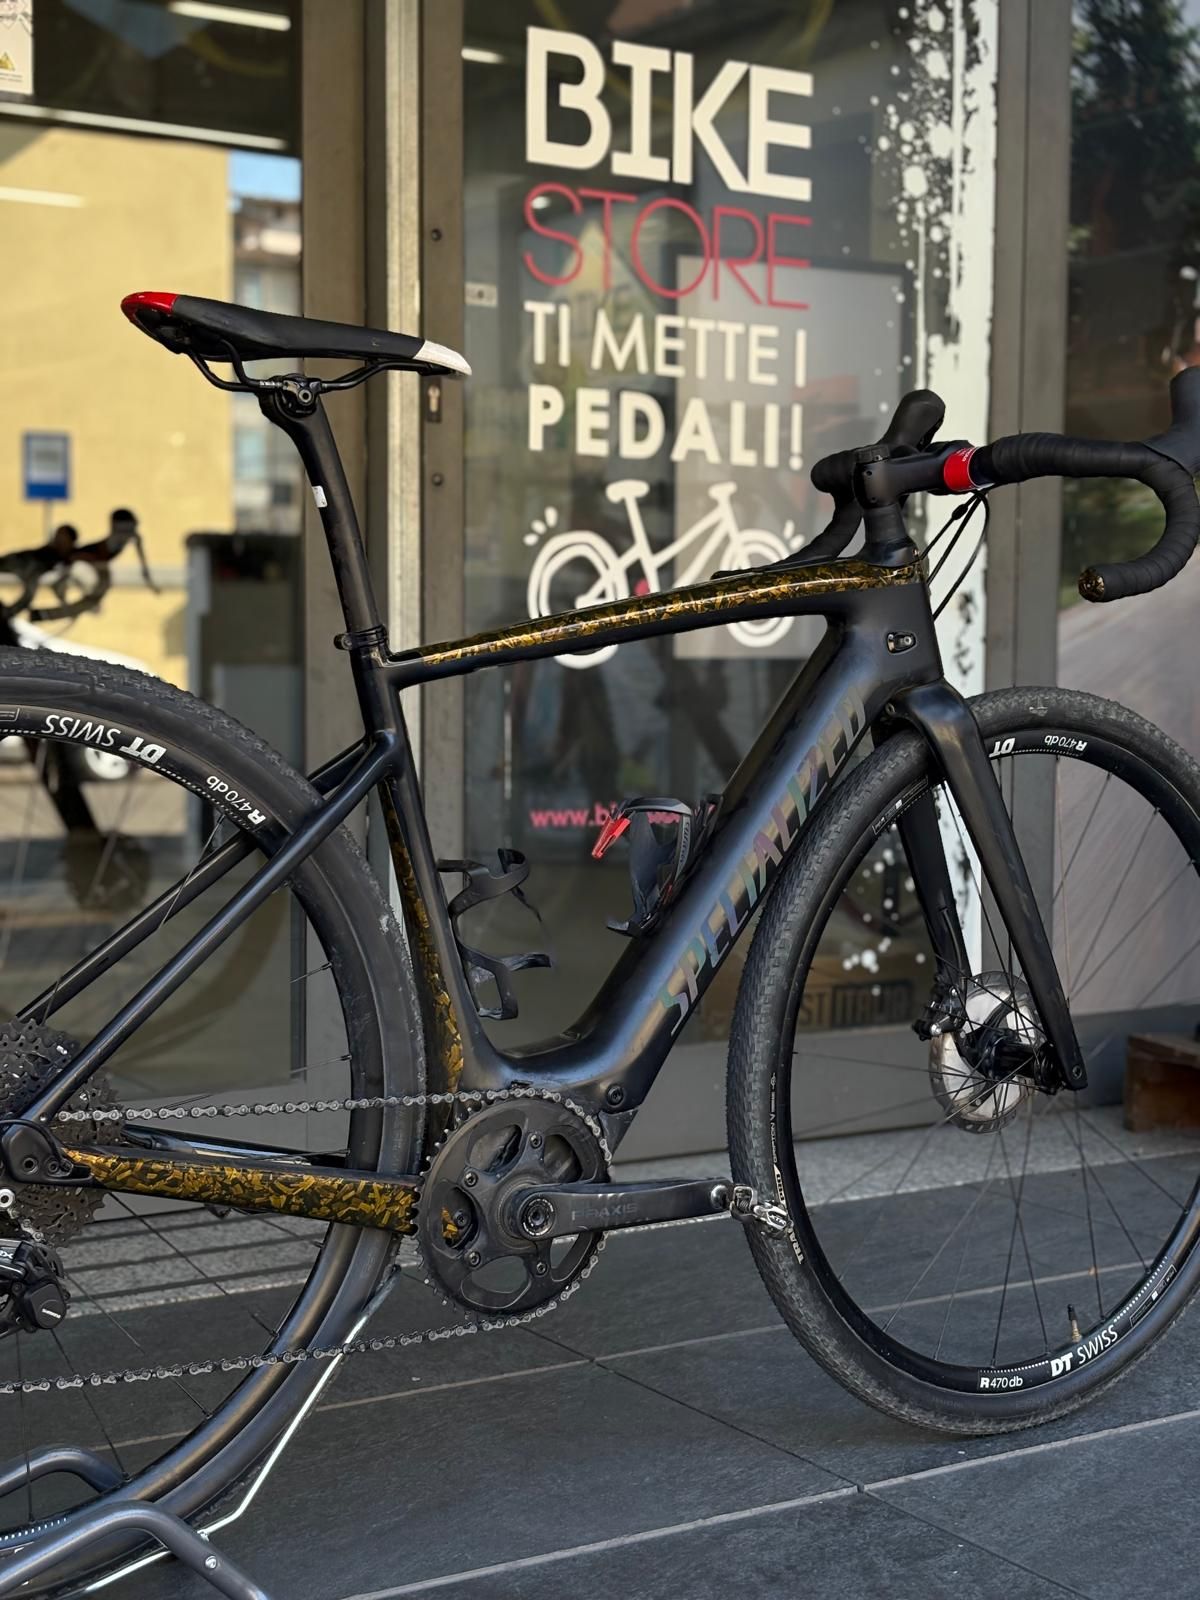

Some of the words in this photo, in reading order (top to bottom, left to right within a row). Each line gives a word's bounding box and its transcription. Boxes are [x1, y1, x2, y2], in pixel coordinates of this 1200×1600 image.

[525, 25, 814, 202] BIKE
[524, 182, 813, 310] STORE
[524, 300, 571, 367] TI
[591, 307, 779, 386] METTE
[795, 328, 806, 388] I
[528, 383, 803, 470] PEDALI!
[41, 714, 121, 747] SWISS
[119, 736, 167, 764] DT
[988, 737, 1016, 758] DT
[1050, 1352, 1074, 1377] DT
[1077, 1324, 1119, 1365] SWISS
